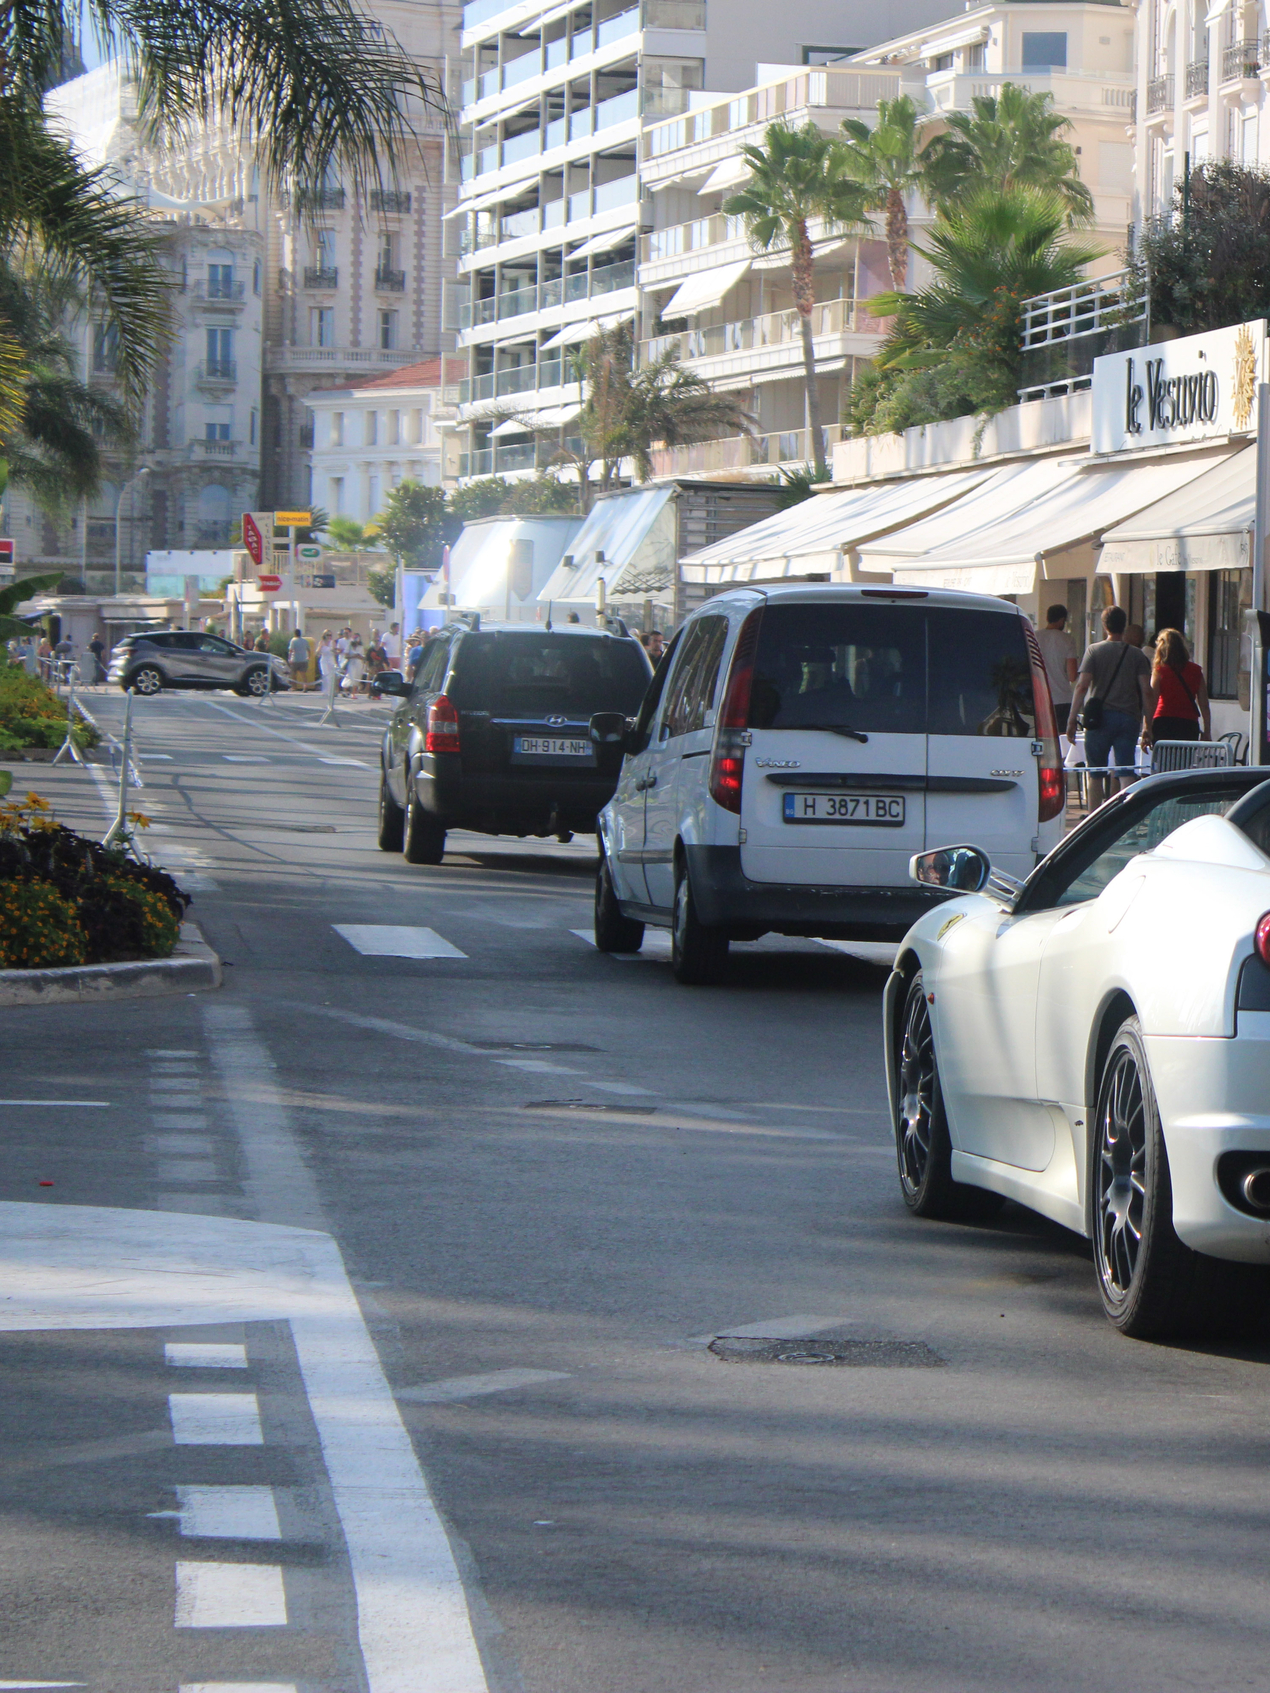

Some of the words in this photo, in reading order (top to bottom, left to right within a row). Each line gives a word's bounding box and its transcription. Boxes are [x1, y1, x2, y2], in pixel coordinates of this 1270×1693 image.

[1125, 357, 1142, 435] le
[1145, 350, 1217, 431] Vesuvio
[246, 524, 259, 554] TABAC
[521, 738, 586, 755] DH-914-NH
